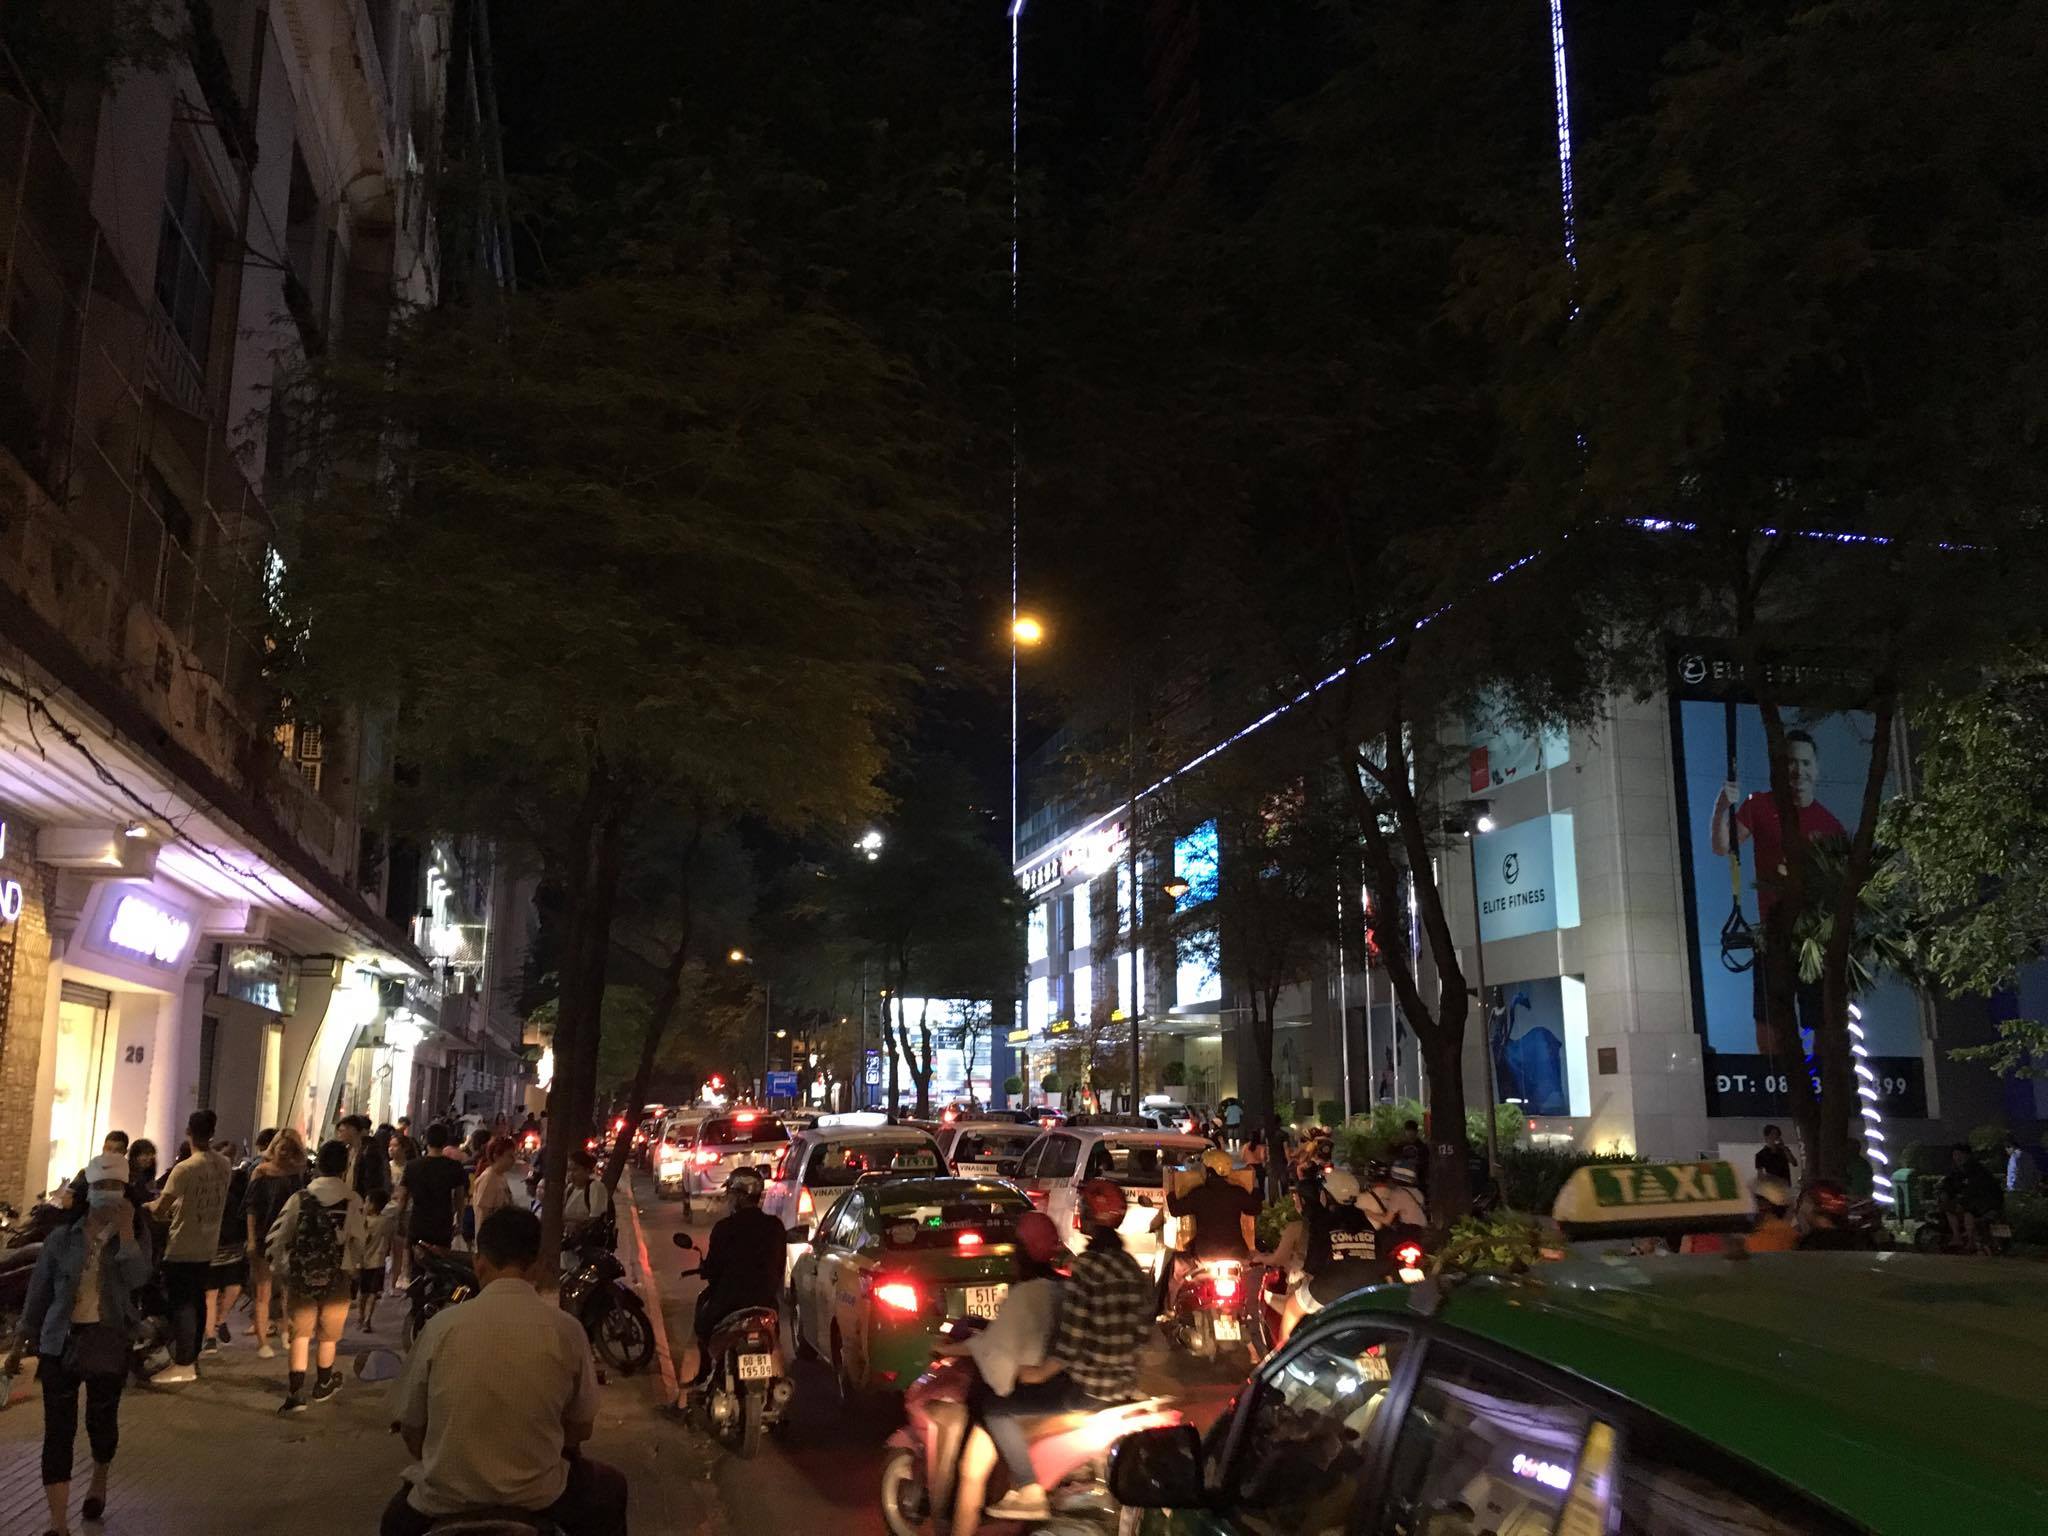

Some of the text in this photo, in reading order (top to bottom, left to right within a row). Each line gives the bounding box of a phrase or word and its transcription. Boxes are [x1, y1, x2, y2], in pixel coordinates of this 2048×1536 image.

[1483, 888, 1545, 914] ELITE FITNESS
[975, 1287, 998, 1304] 51F
